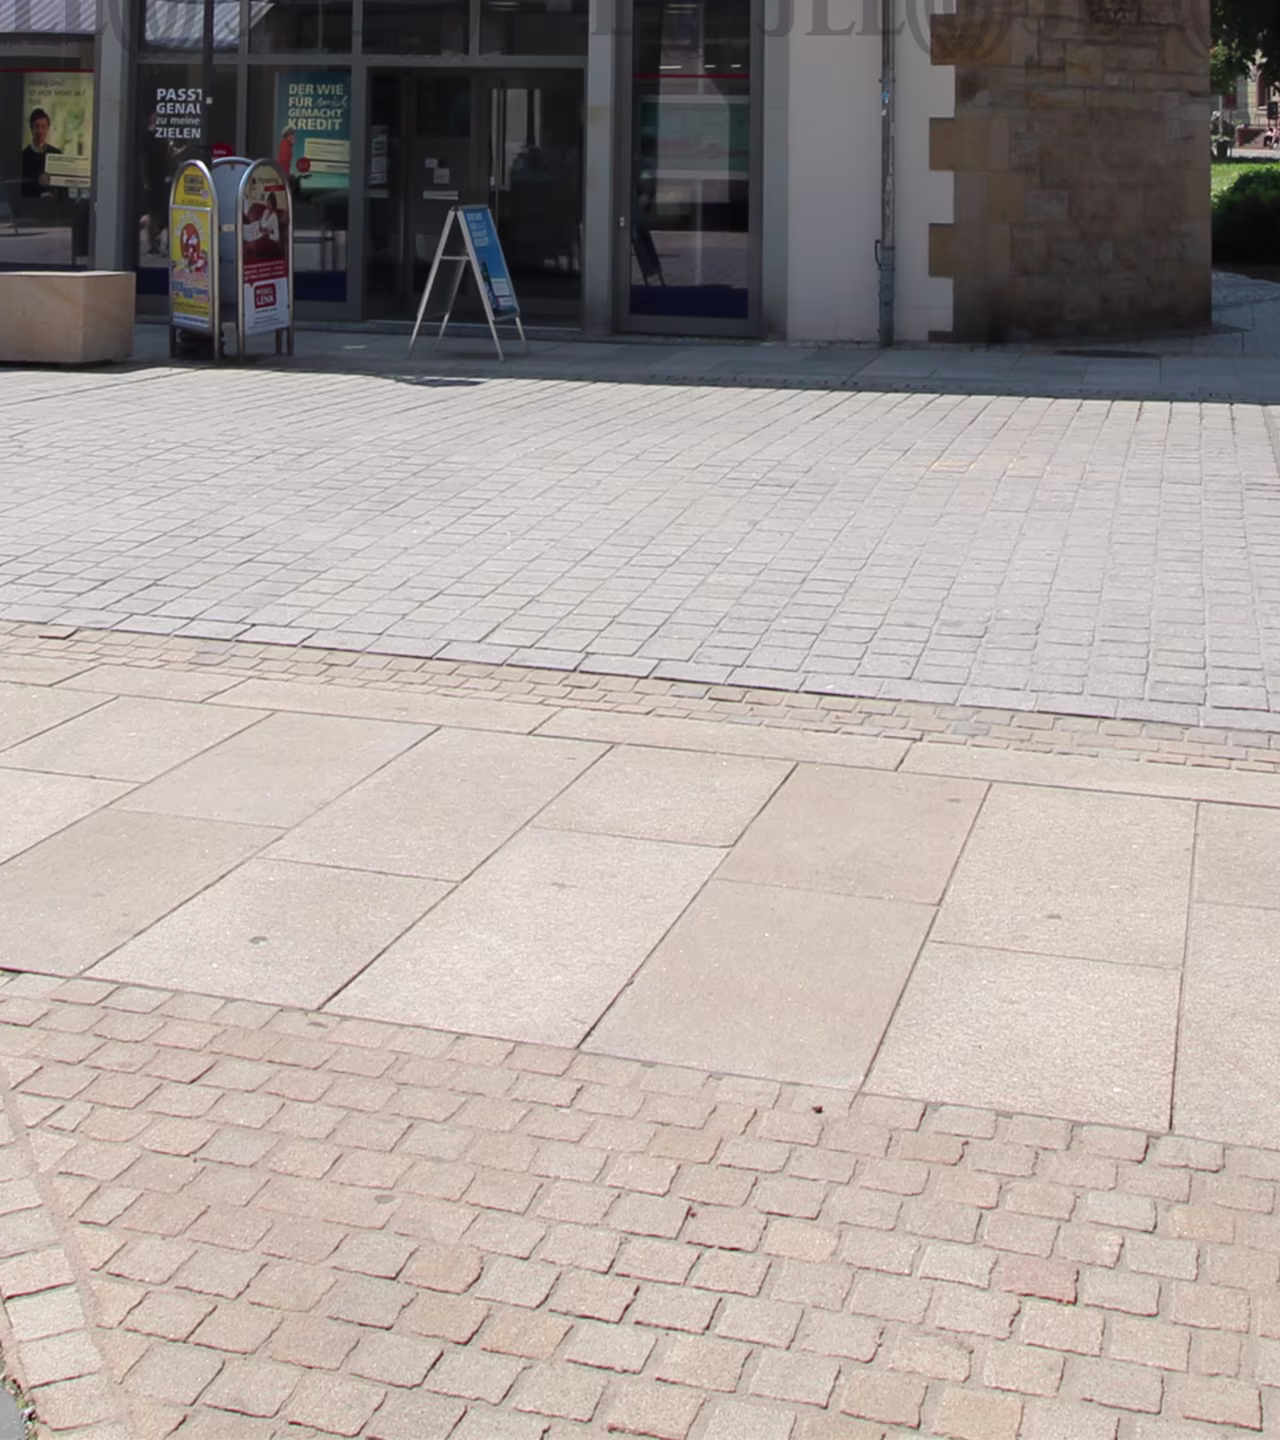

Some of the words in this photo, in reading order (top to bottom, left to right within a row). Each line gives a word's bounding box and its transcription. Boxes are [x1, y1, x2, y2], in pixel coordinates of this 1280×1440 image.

[156, 88, 203, 101] PASST
[288, 83, 315, 95] DER
[316, 83, 345, 95] WIE
[287, 108, 343, 117] GEMACHT
[170, 116, 201, 125] meine
[287, 118, 343, 130] KREDIT
[155, 127, 201, 138] ZIELEN
